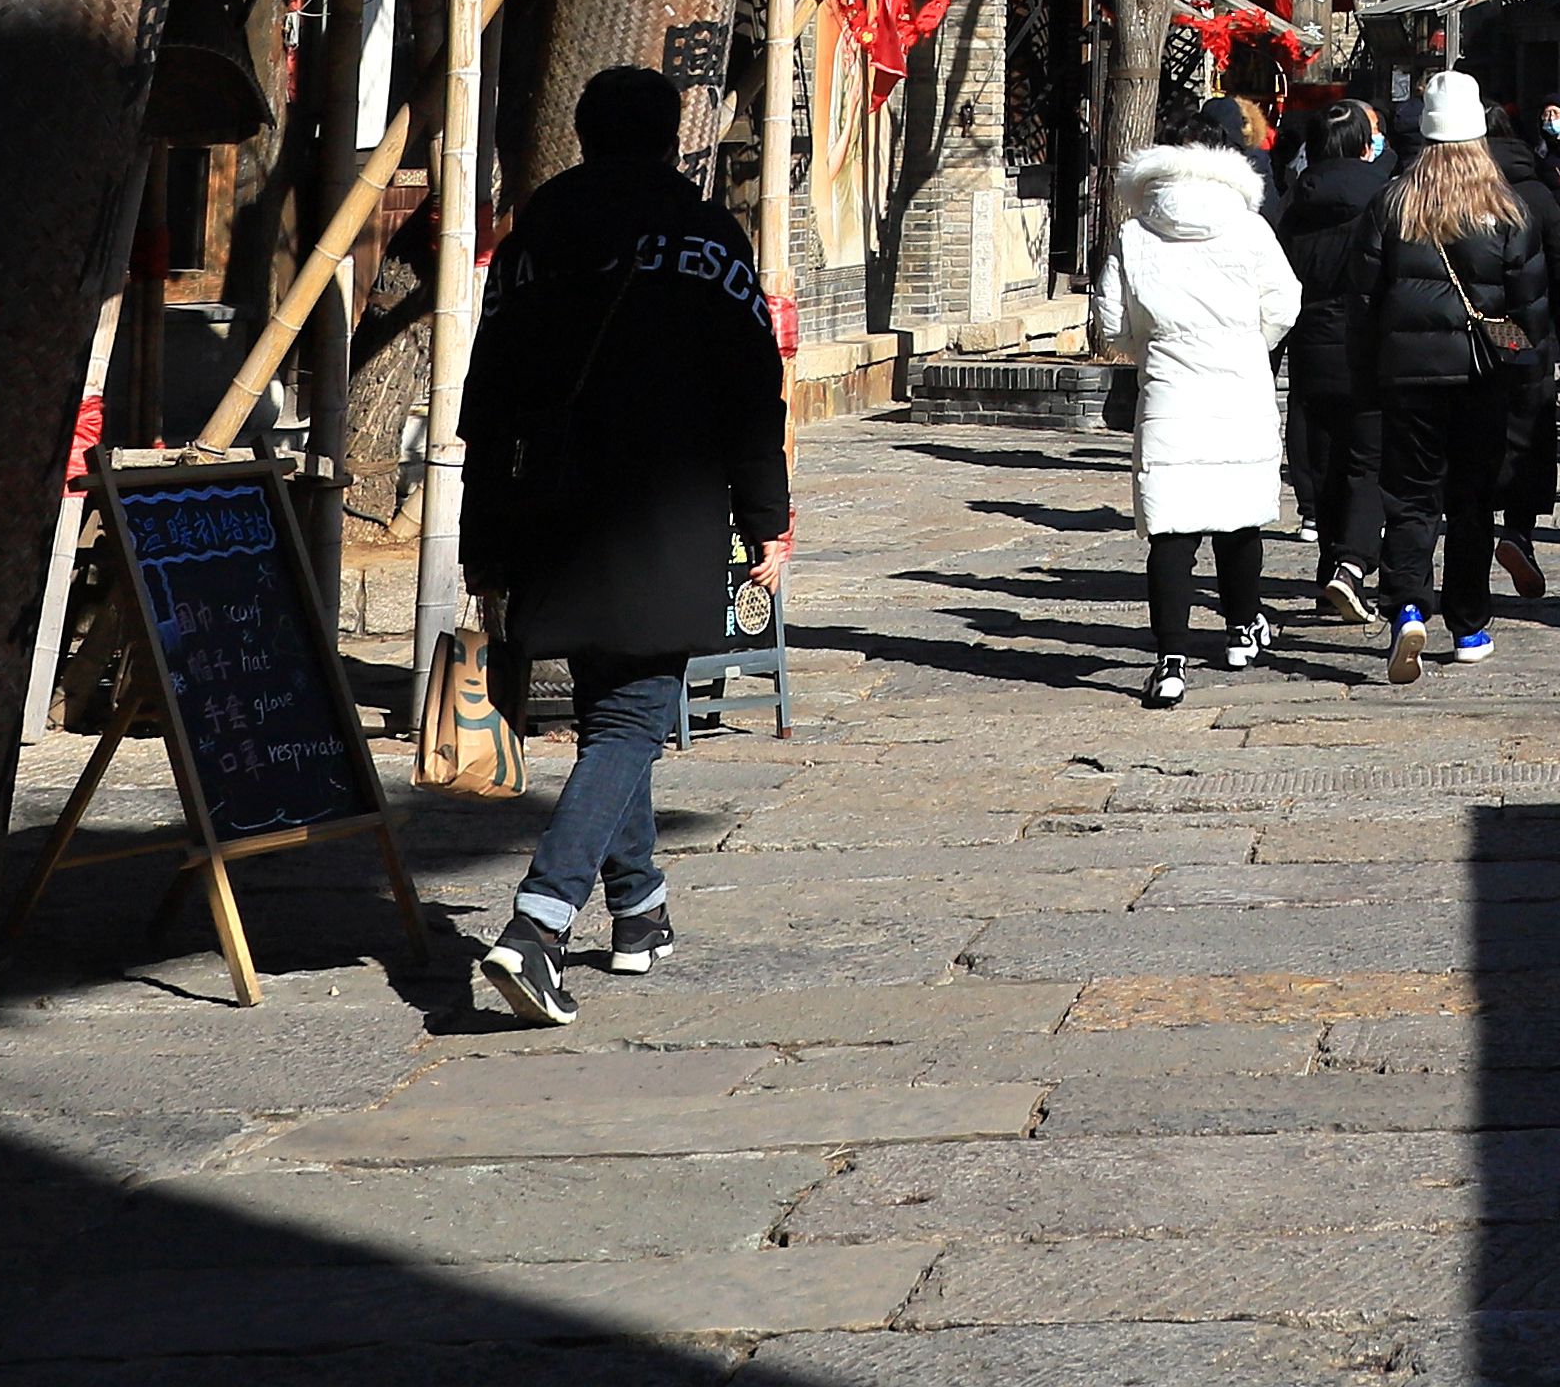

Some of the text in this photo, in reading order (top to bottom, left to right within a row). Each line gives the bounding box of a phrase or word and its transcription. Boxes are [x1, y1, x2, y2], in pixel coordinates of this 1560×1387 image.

[134, 507, 270, 553] 温暖补给站
[187, 647, 272, 683] 帽子 hat
[203, 691, 295, 734] 手套 glove
[220, 739, 265, 781] 口罩
